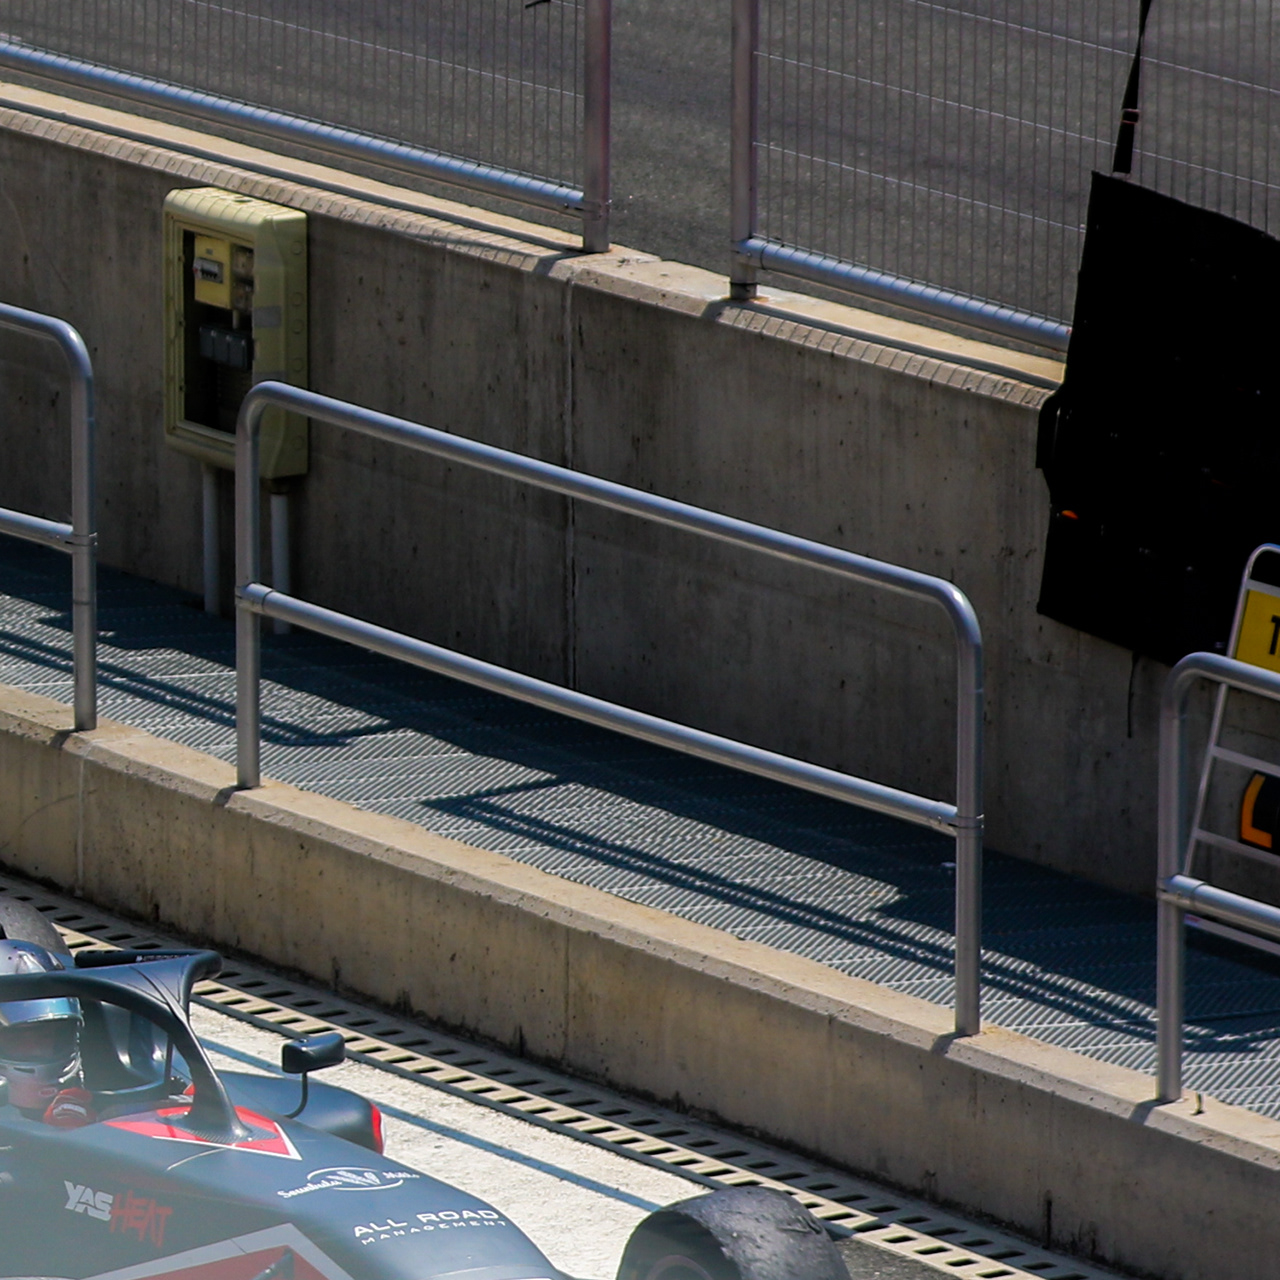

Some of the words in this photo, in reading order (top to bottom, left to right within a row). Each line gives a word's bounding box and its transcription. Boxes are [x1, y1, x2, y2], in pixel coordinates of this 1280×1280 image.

[63, 1179, 114, 1222] YAS
[109, 1189, 174, 1249] HEAT
[353, 1217, 408, 1238] ALL
[415, 1209, 500, 1224] ROAD
[360, 1219, 507, 1246] MANAGEMENT
